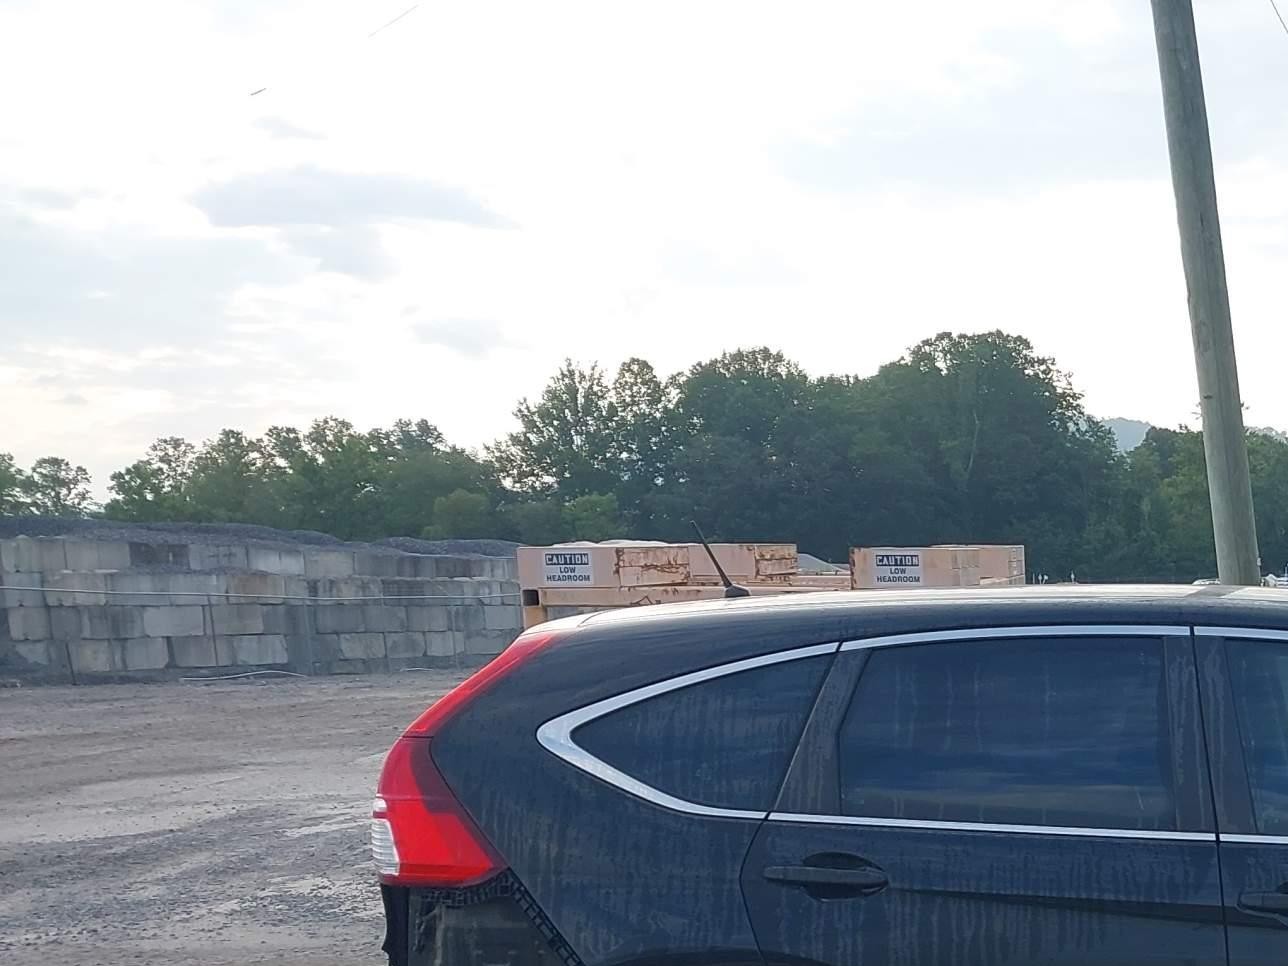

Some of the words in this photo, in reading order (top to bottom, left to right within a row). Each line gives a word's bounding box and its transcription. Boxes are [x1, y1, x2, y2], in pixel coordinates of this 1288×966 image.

[546, 554, 588, 565] CAUTION
[876, 555, 919, 566] CAUTION
[559, 566, 576, 574] LOW
[889, 567, 907, 575] LOW
[546, 574, 591, 582] HEADROOM
[876, 575, 921, 583] HEADROOM
